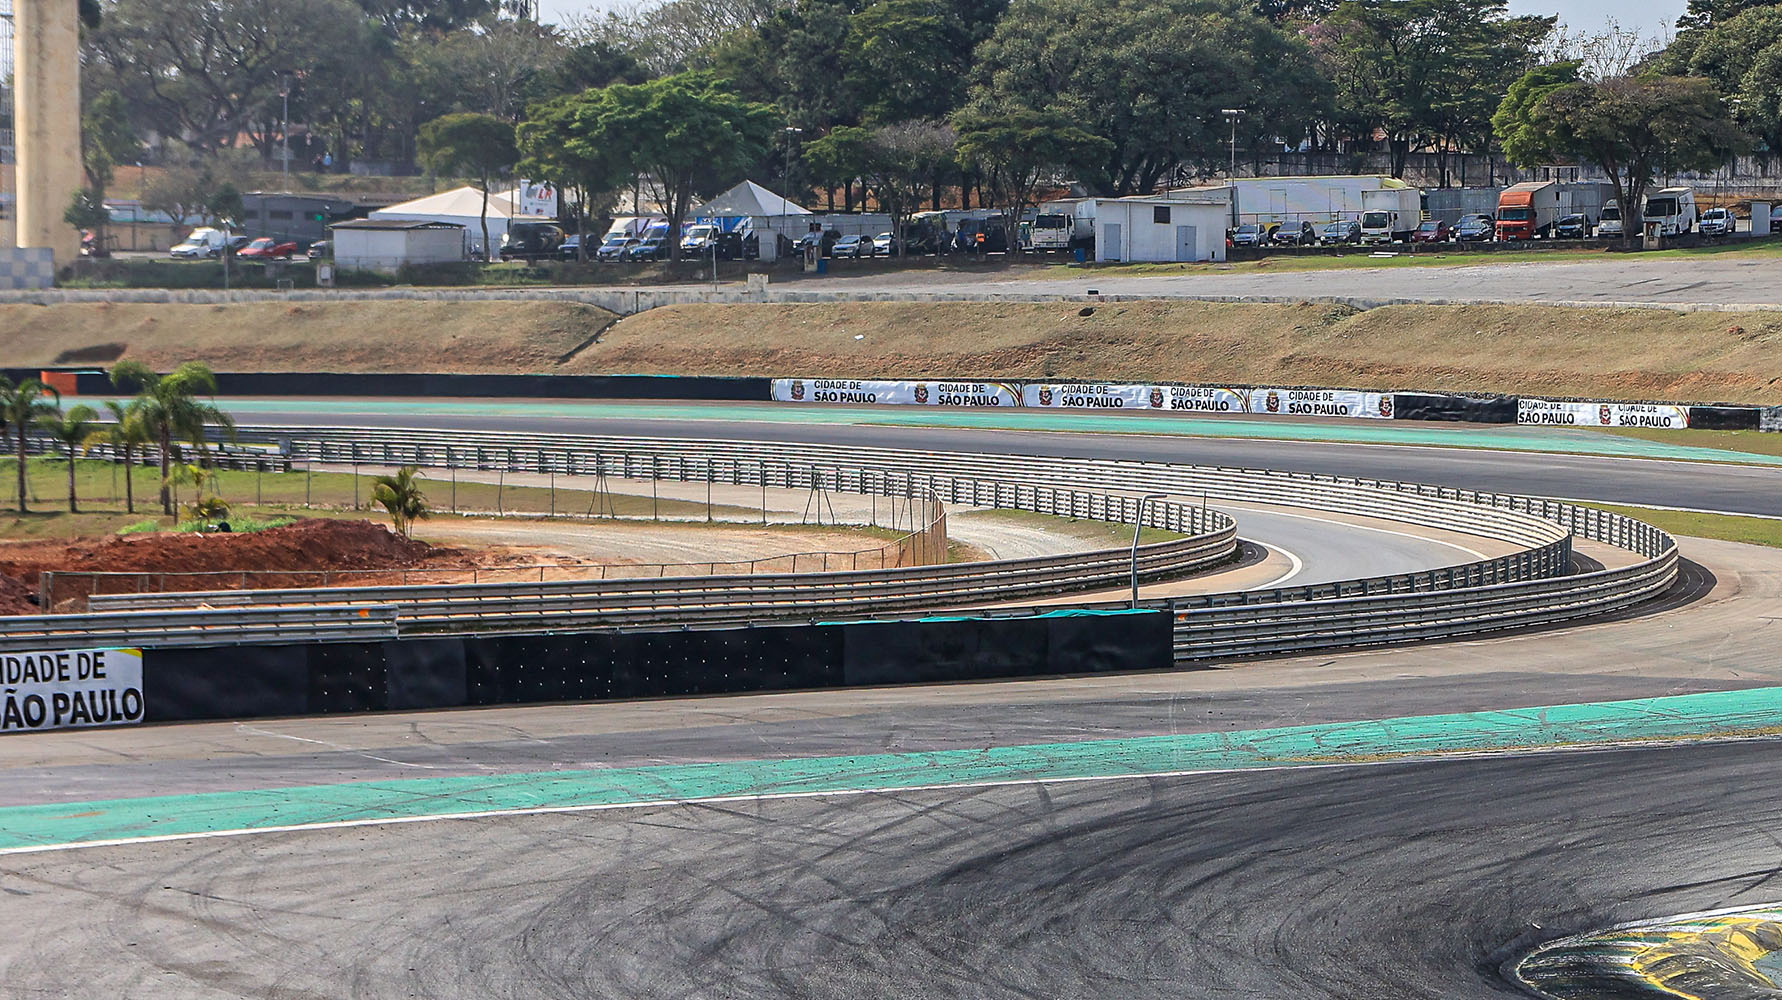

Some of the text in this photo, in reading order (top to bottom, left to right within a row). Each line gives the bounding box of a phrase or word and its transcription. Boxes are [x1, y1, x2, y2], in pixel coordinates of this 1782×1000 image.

[814, 380, 862, 390] CIDADE DE
[938, 383, 985, 393] CIDADE DE
[1061, 385, 1109, 394] CIDADE DE
[814, 389, 876, 403] SÃO PAULO
[938, 392, 1000, 406] SÃO PAULO
[1170, 387, 1215, 398] CIDADE DE
[1288, 391, 1334, 401] CIDADE DE
[1062, 394, 1123, 408] SÃO PAULO
[1170, 397, 1229, 411] SÃO PAULO
[1288, 401, 1348, 415] SÃO PAULO
[1518, 410, 1574, 424] SÃO PAULO
[1619, 412, 1671, 428] SÃO PAULO
[77, 652, 106, 681] DE
[0, 687, 143, 729] ÃO PAULO
